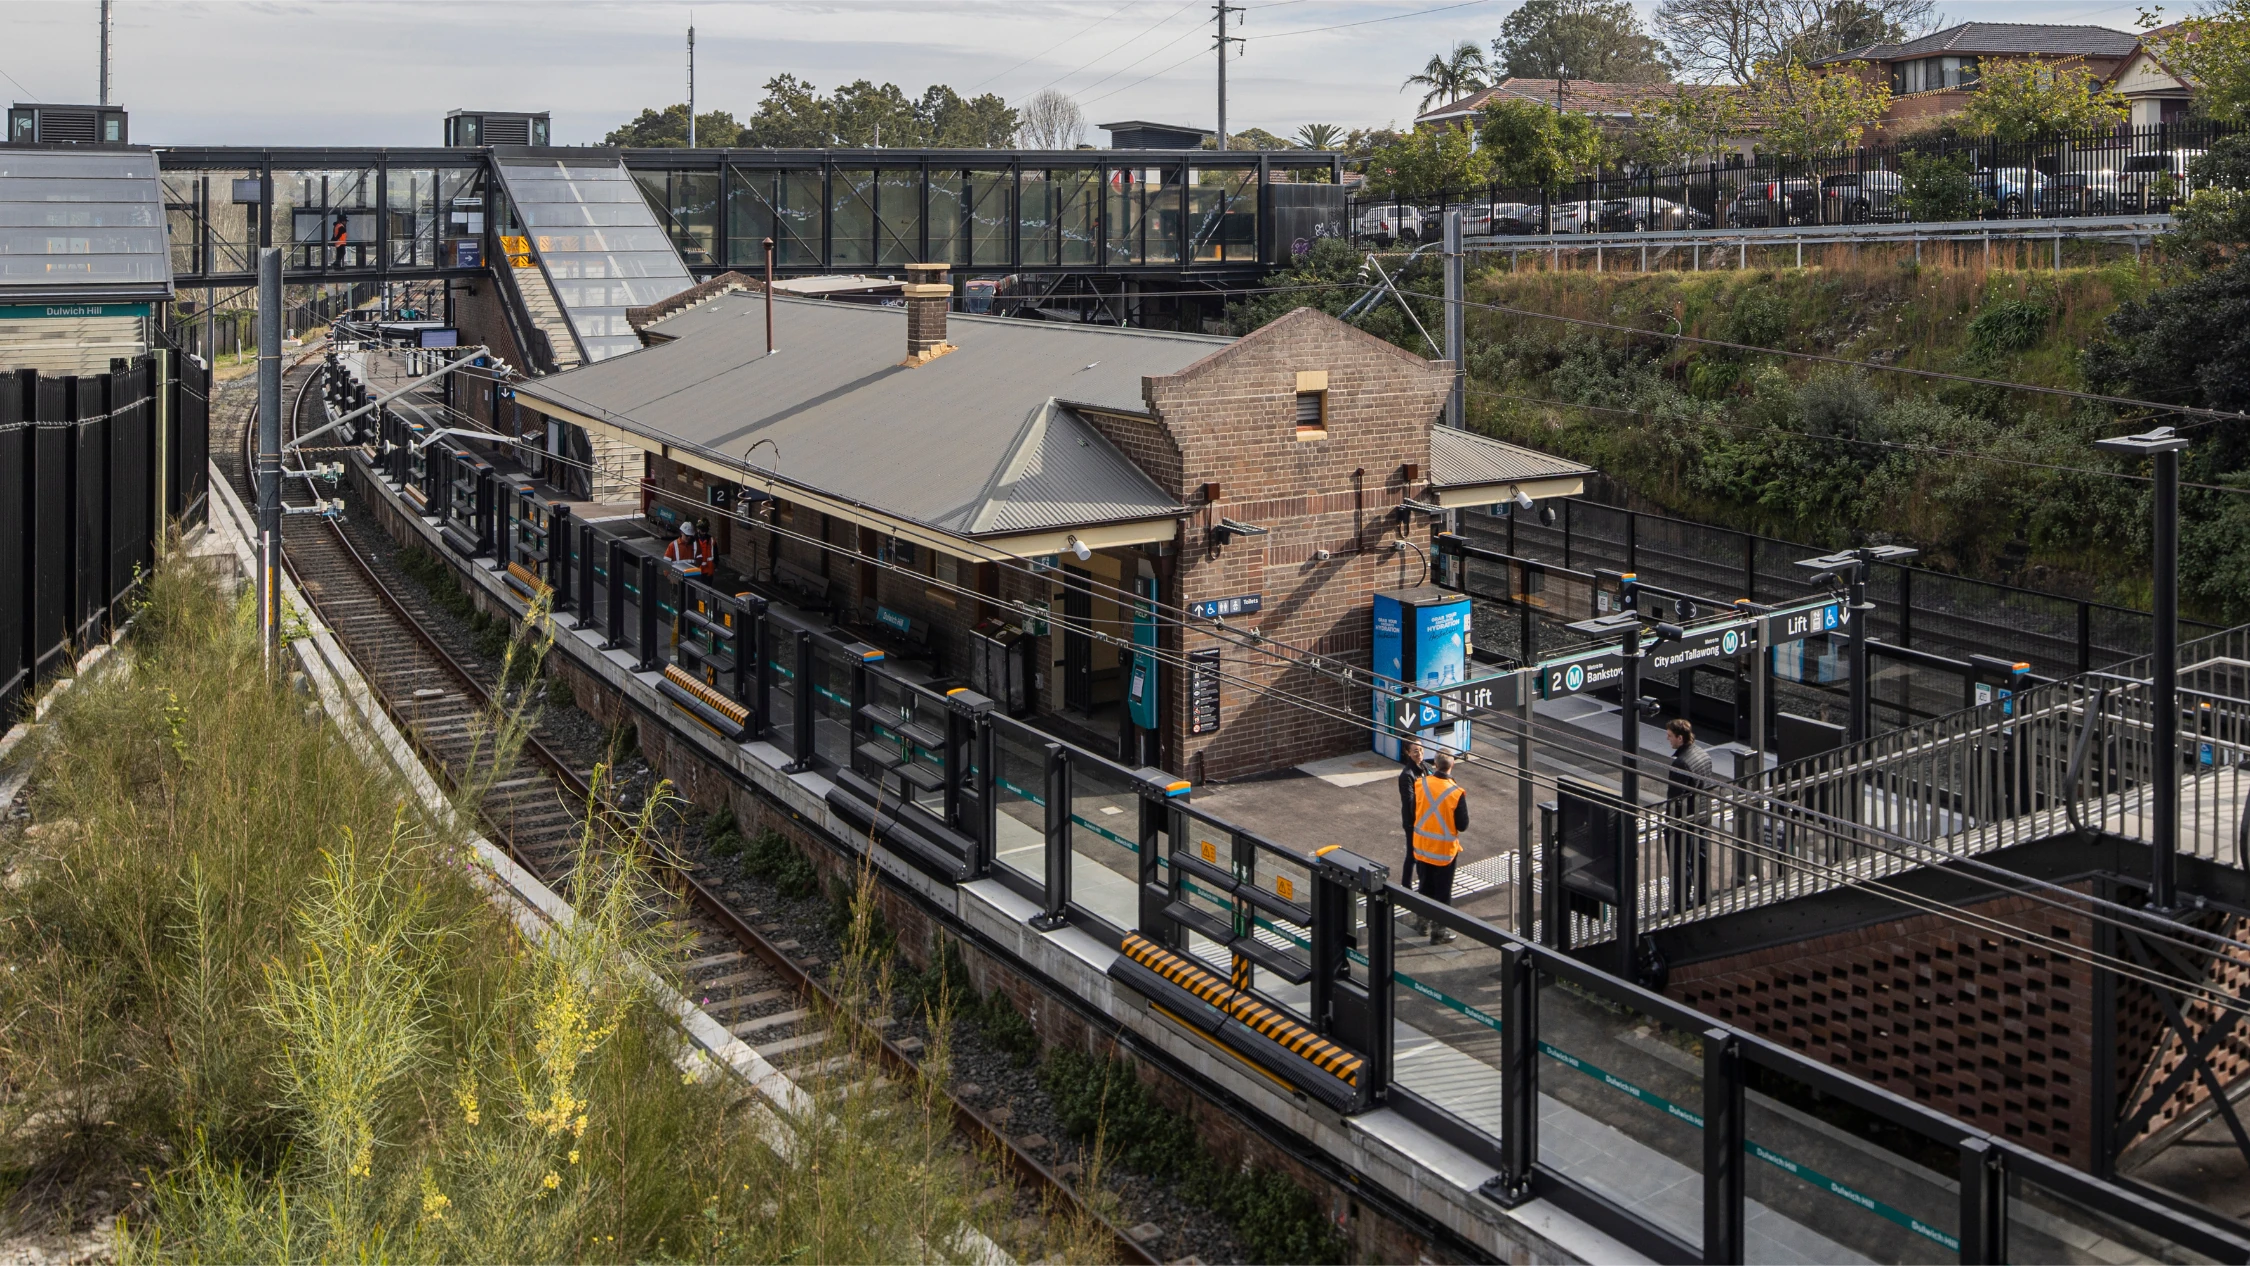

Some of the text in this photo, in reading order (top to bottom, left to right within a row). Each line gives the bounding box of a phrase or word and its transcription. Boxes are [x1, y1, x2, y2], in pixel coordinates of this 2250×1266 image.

[46, 306, 102, 316] Dulwich Hill
[716, 490, 725, 502] 2
[1375, 624, 1401, 633] HYDRATION
[1426, 619, 1461, 632] HYDRATION
[1788, 615, 1808, 635] Lift
[1740, 630, 1748, 648] 1
[1654, 645, 1720, 668] City and Tallawong
[1552, 672, 1562, 692] 2
[1466, 687, 1493, 711] Lift
[1414, 982, 1443, 1001] Dulwich Hill
[1464, 1006, 1494, 1026] Dulwich Hill
[1546, 1046, 1579, 1067] Dulwich Hill
[1605, 1074, 1640, 1097] Dulwich Hill
[1668, 1104, 1695, 1122] Dulwich
[1756, 1147, 1797, 1173] Dulwich Hill
[1830, 1181, 1875, 1210] Dulwich Hill
[1911, 1219, 1959, 1250] Dulwich Hill
